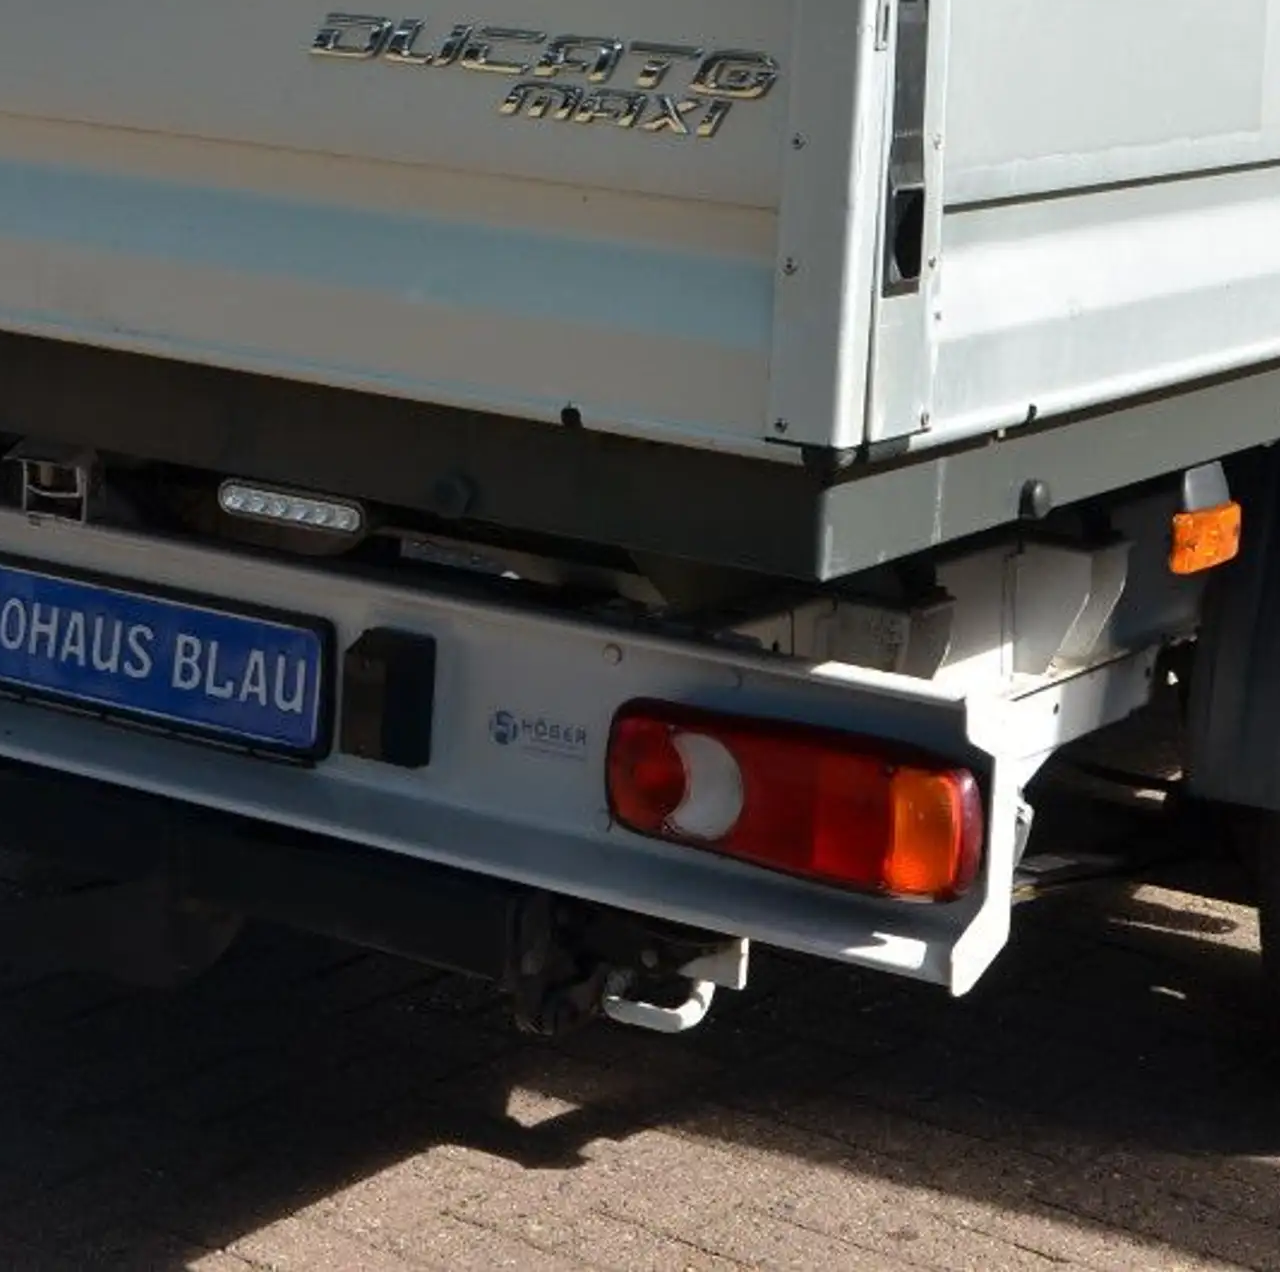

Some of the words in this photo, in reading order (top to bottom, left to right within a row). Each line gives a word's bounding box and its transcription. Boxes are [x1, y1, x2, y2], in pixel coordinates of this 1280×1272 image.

[310, 11, 780, 99] DUCATO
[500, 80, 733, 138] MAXI
[171, 632, 307, 714] BLAU
